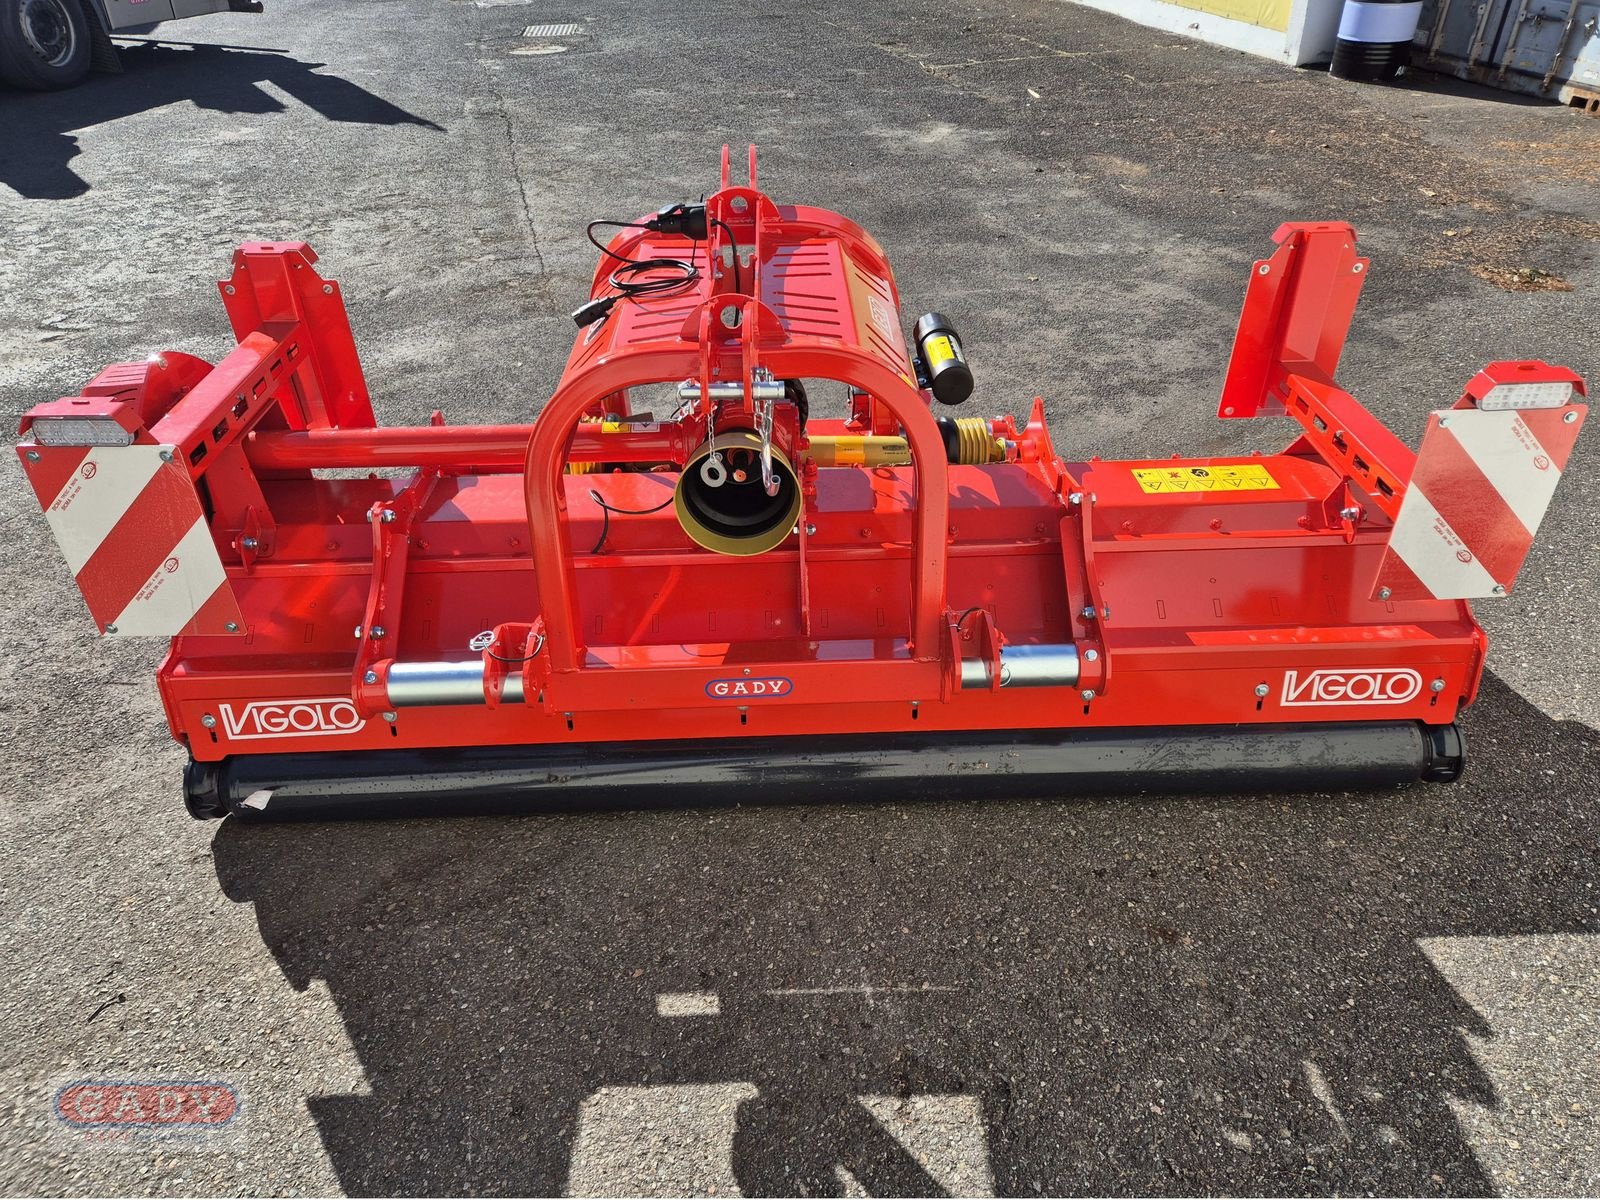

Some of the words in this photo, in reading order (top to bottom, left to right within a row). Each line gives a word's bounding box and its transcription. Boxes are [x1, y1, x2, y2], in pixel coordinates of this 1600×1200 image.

[714, 680, 783, 695] GADY
[1280, 668, 1422, 706] VIGOLO
[218, 698, 361, 740] VIGOLO
